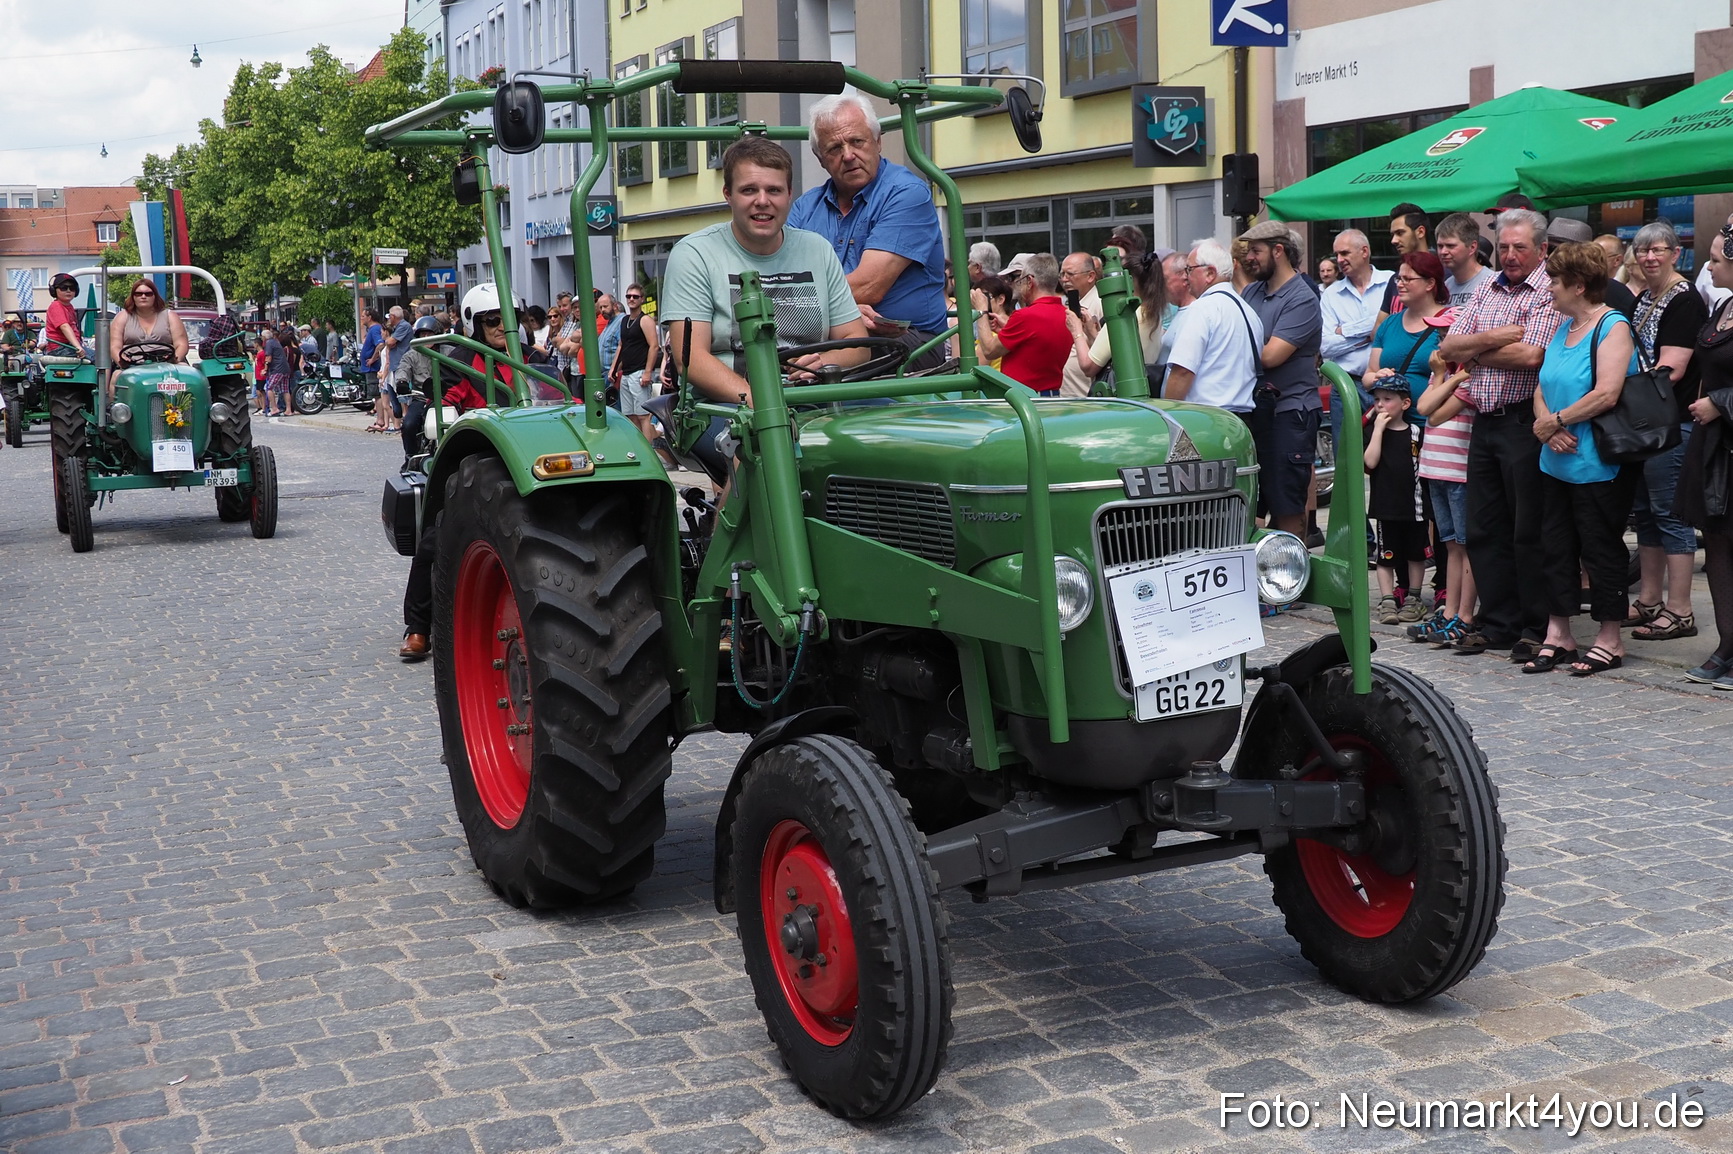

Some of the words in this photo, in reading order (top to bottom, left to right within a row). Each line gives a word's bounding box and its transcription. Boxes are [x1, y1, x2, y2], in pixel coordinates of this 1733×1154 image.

[1295, 71, 1323, 86] Unterer
[1324, 64, 1347, 81] Markt
[1349, 60, 1359, 76] 15
[1163, 107, 1189, 141] G2
[1379, 158, 1464, 171] Neumarkter
[1347, 165, 1461, 185] Lammsbräu
[591, 205, 607, 223] G2
[157, 383, 186, 391] Kramer
[171, 445, 186, 453] 450
[207, 478, 220, 487] BR
[220, 477, 236, 485] 393
[210, 471, 223, 479] NM
[1122, 459, 1238, 497] FENDT
[959, 505, 1023, 524] Farmer
[1183, 565, 1229, 598] 576
[1155, 684, 1190, 714] GG
[1194, 678, 1226, 709] 22
